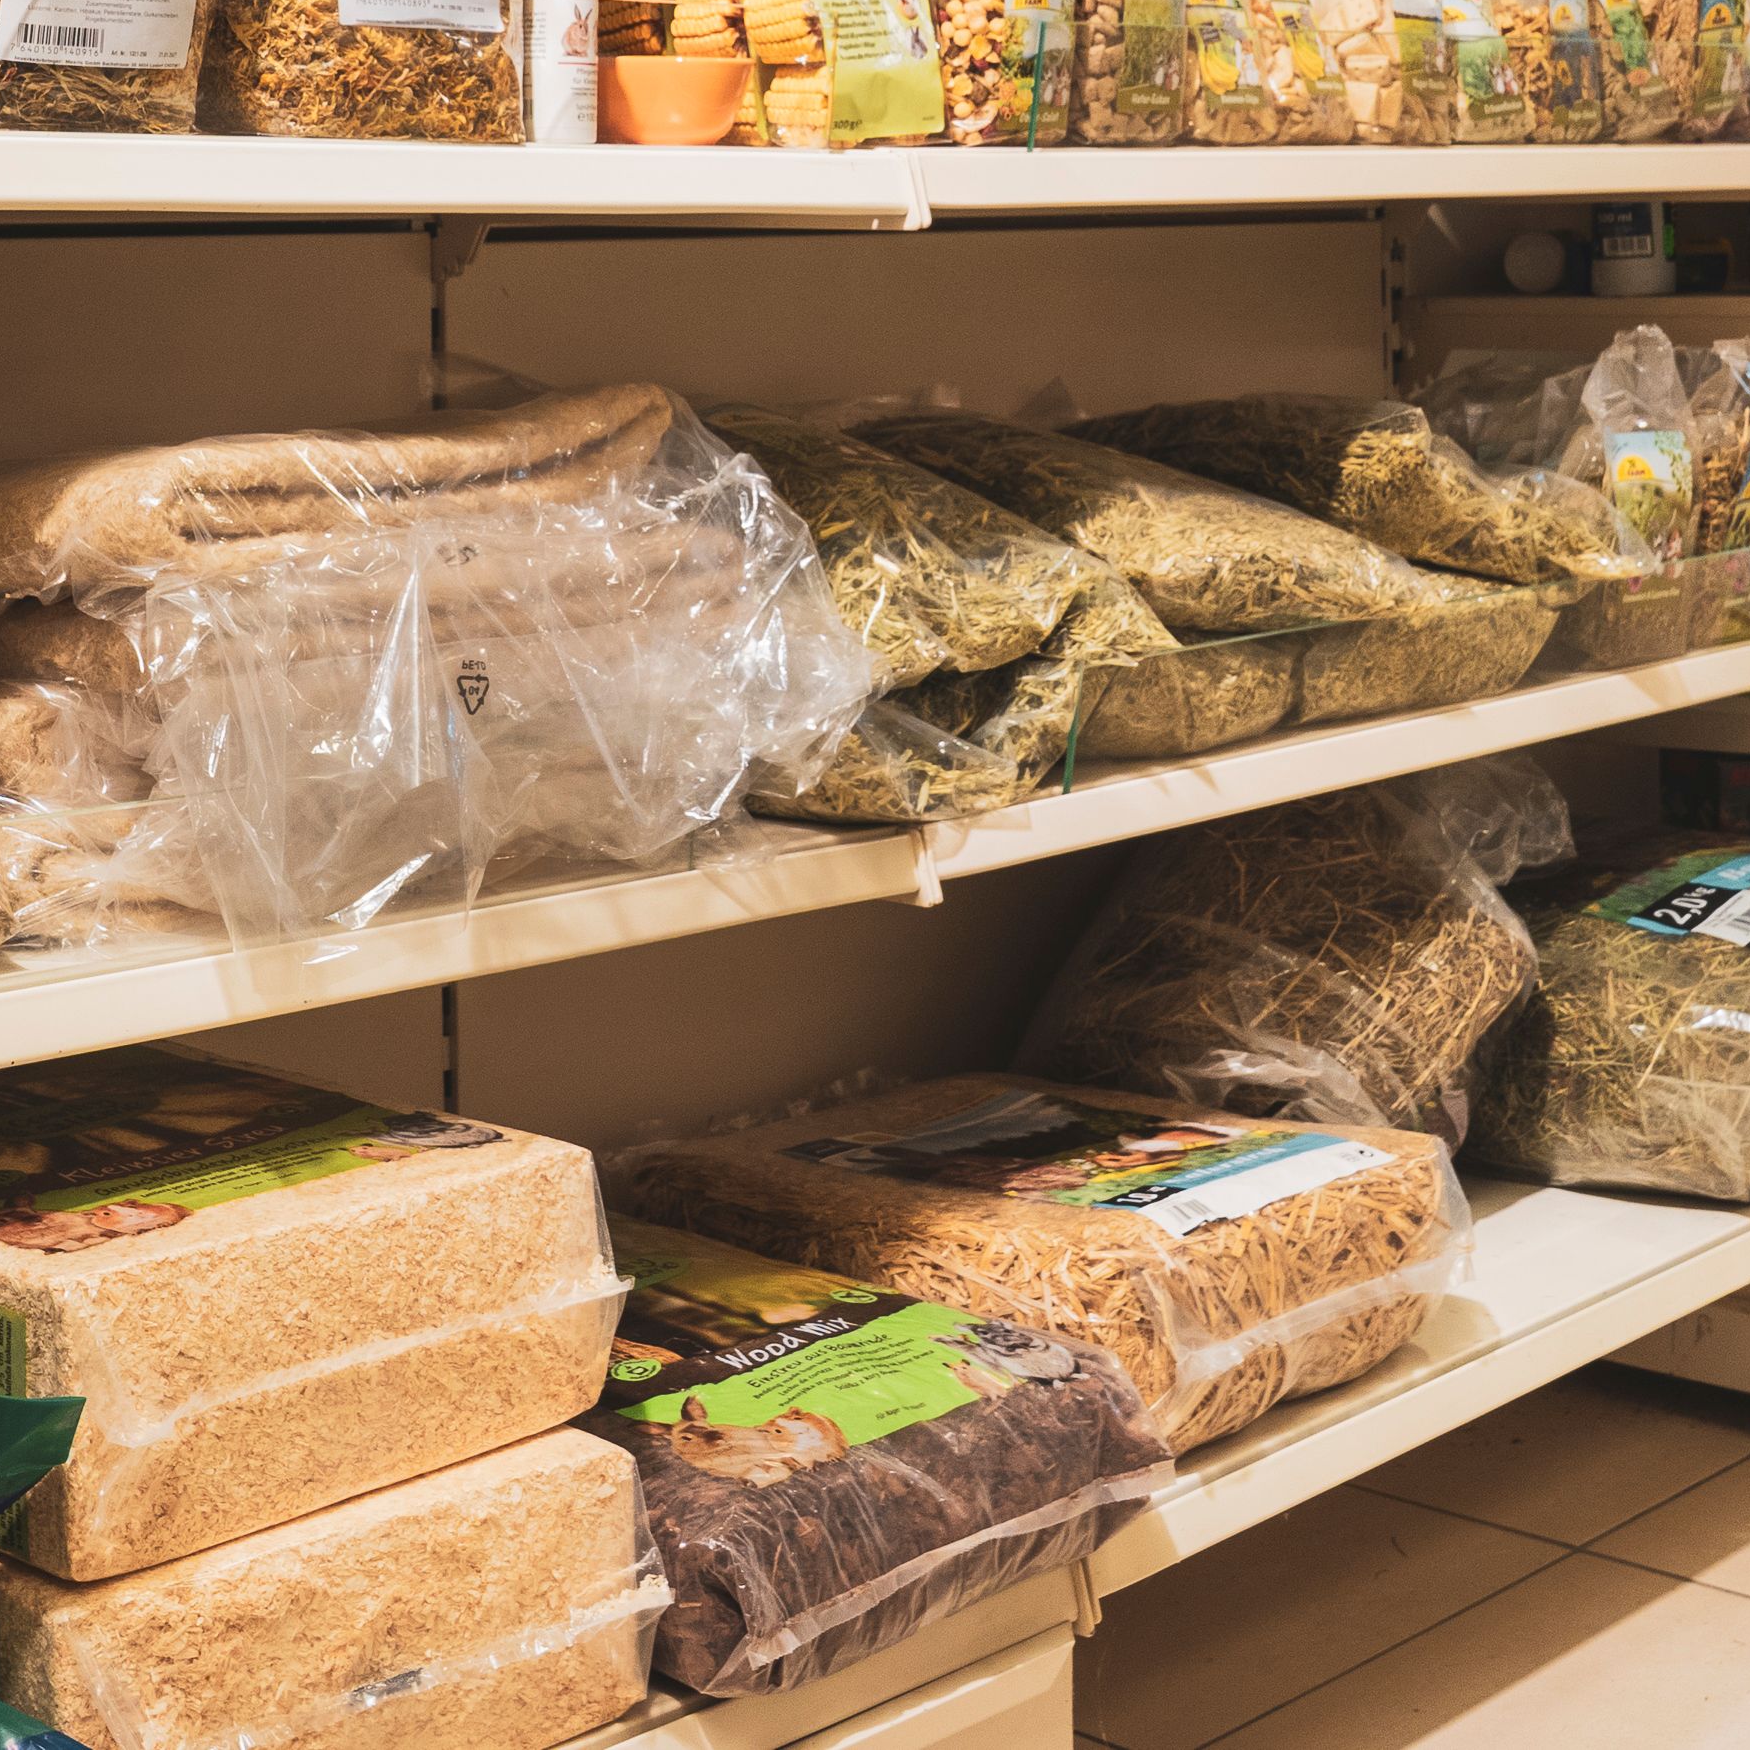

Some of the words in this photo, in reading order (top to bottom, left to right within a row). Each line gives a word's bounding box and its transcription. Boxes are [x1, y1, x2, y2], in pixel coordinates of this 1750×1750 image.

[1667, 895, 1706, 926] 2,0
[57, 1148, 203, 1184] Kleintier
[204, 1123, 284, 1151] Streu
[715, 1332, 798, 1371] Wood
[794, 1316, 859, 1338] Mix
[747, 1358, 802, 1389] Einstreu
[805, 1346, 826, 1365] aus
[827, 1333, 892, 1353] Baumrinde
